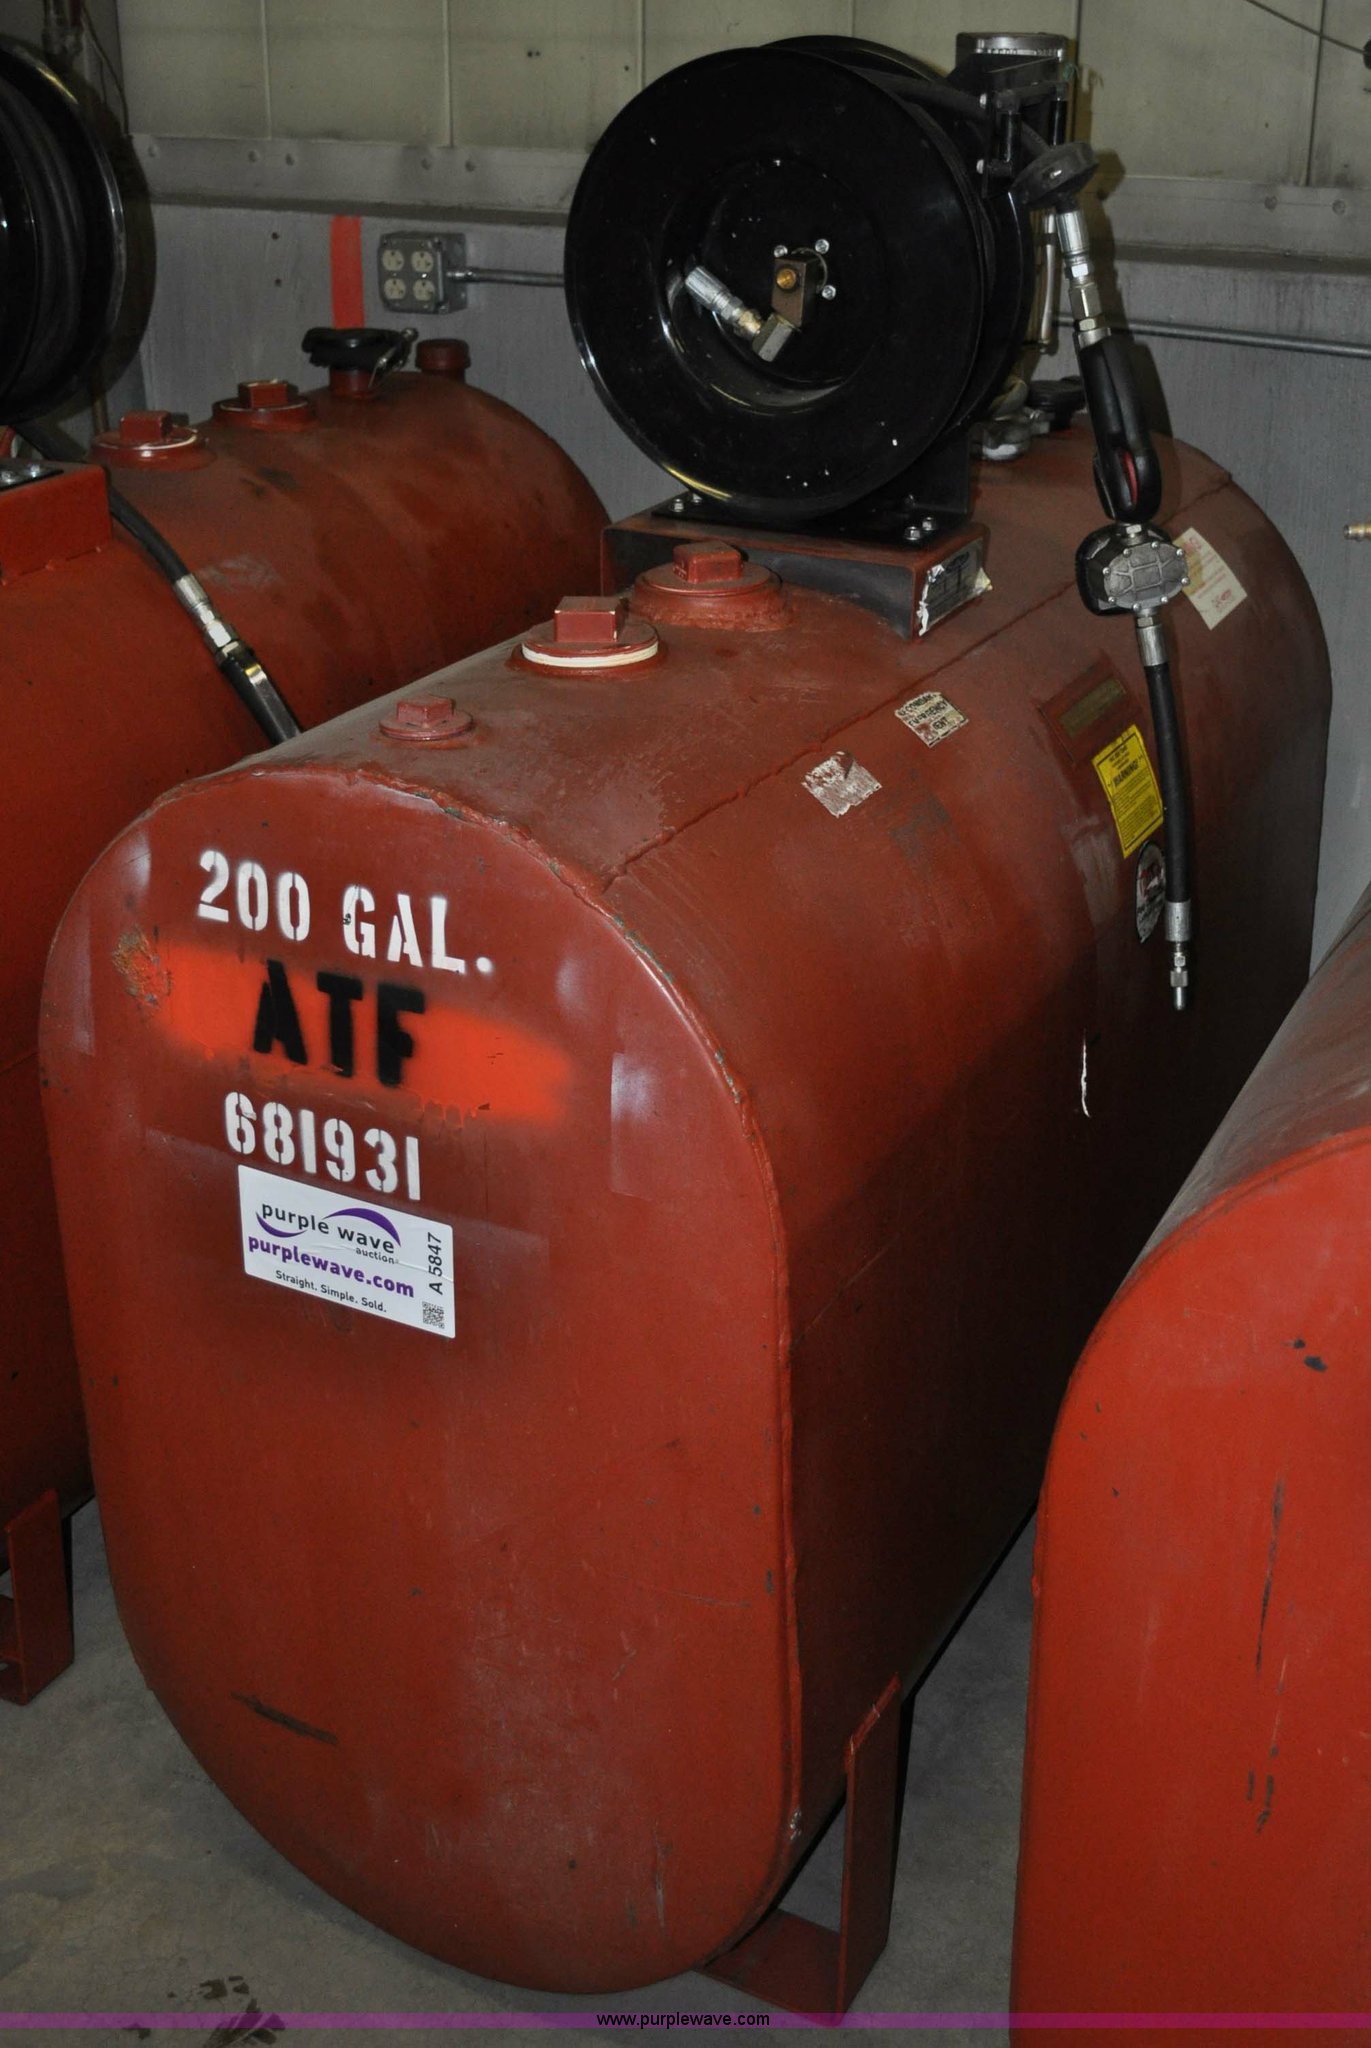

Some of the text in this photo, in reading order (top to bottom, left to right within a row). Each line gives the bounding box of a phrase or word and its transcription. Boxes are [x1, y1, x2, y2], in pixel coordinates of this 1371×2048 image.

[197, 849, 494, 976] 200 GAL.
[253, 957, 427, 1088] ATF
[224, 1091, 421, 1201] 681931
[262, 1203, 395, 1254] purple wave
[355, 1246, 395, 1265] auction
[248, 1236, 415, 1298] purplewave.com
[275, 1270, 387, 1313] Straight. Simple. Sold.
[427, 1231, 443, 1295] A 5847
